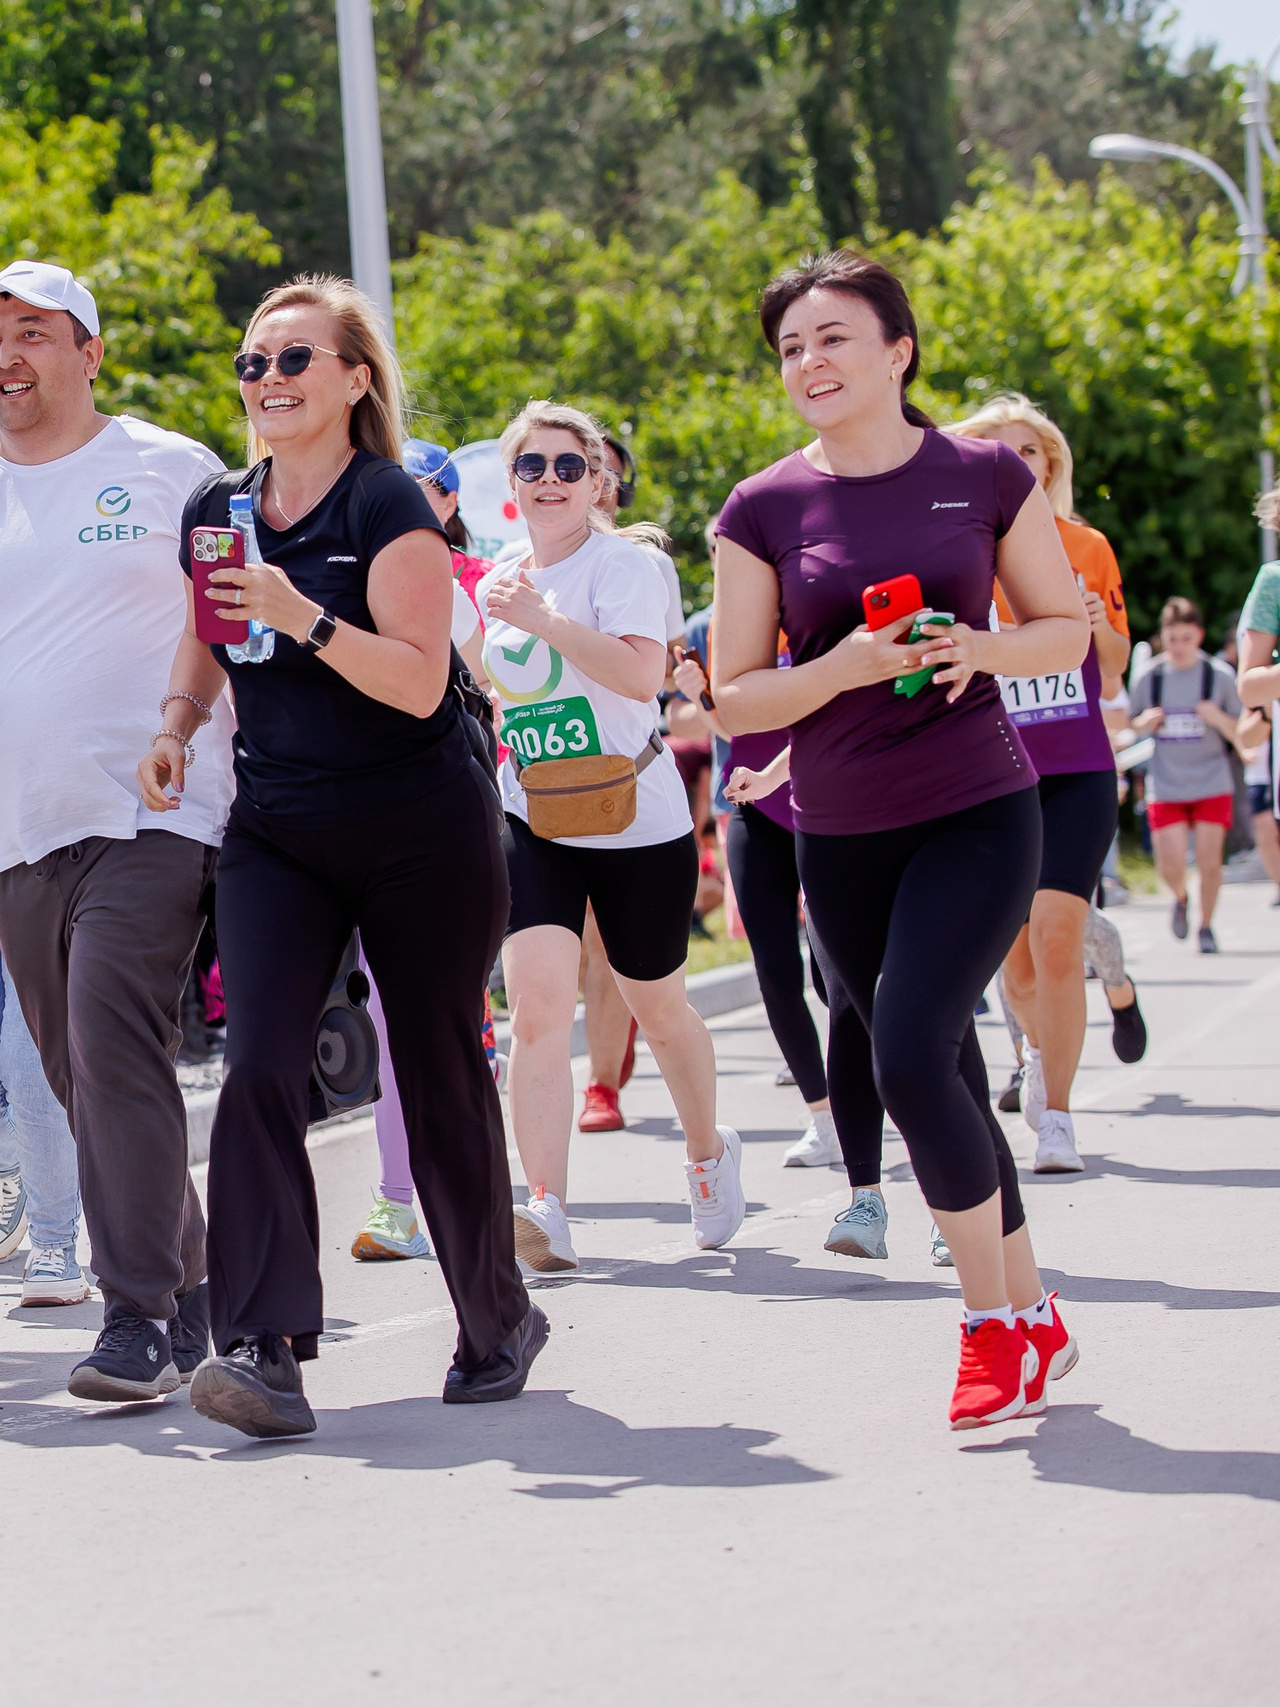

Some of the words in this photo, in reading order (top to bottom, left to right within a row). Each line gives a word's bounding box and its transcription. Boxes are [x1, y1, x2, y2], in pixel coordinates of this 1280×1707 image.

[78, 524, 148, 543] СБЕР
[1008, 673, 1076, 706] 1176
[507, 719, 589, 758] 0063
